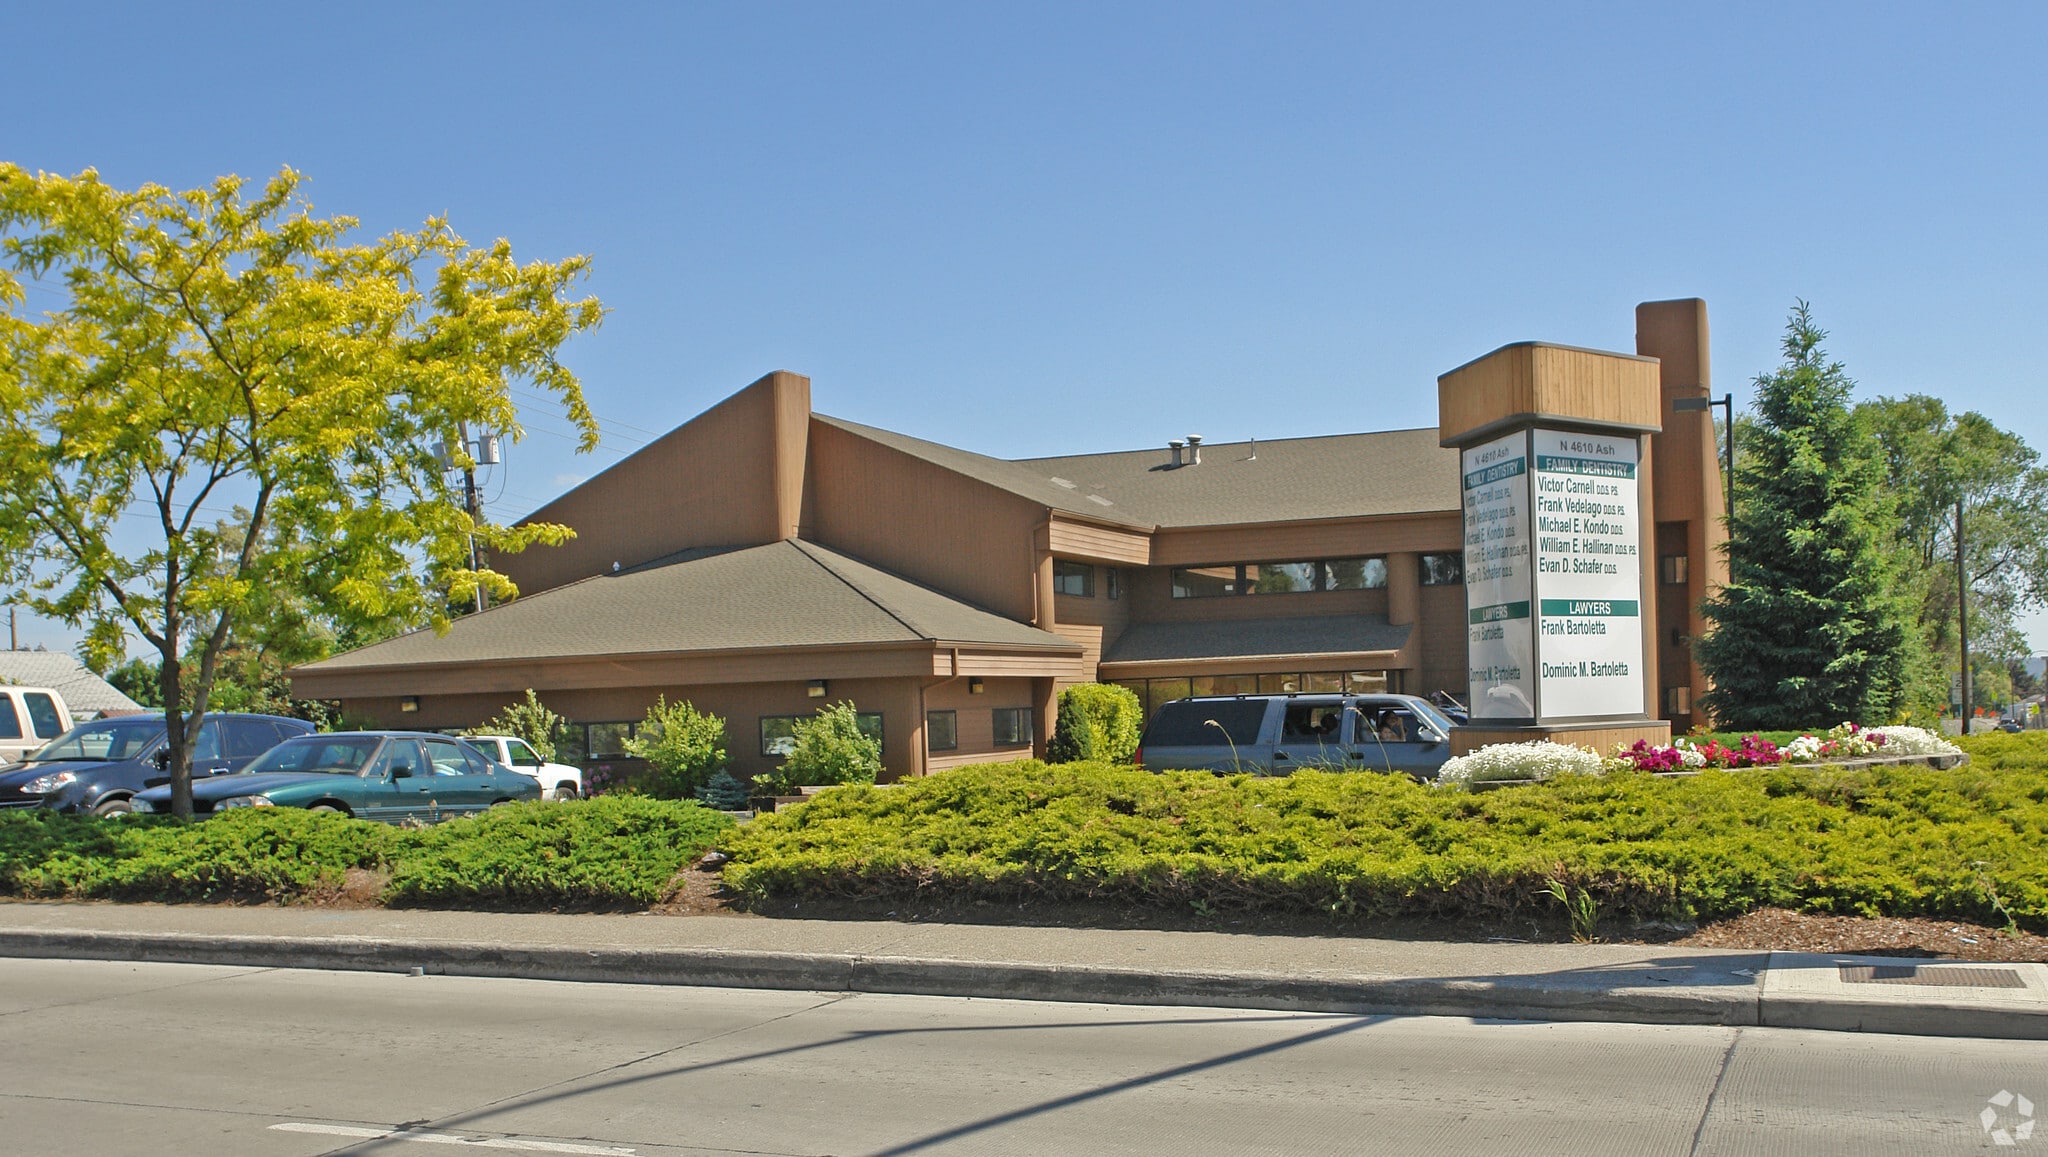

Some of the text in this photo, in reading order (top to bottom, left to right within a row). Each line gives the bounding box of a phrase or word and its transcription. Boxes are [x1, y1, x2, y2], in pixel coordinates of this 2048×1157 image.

[1475, 456, 1480, 466] N
[1497, 446, 1510, 458] Ash
[1560, 441, 1615, 456] N 4610 Ash
[1467, 460, 1518, 488] FAMILY DENTISTRY
[1546, 458, 1628, 477] FAMILY DENTISTRY
[1538, 476, 1564, 493] Victor
[1566, 478, 1595, 495] Carnell
[1538, 496, 1564, 512] Frank
[1566, 498, 1602, 518] Vedelago
[1538, 516, 1572, 533] Michael
[1574, 518, 1582, 534] E.
[1584, 518, 1609, 534] Kondo
[1539, 537, 1570, 552] William
[1572, 538, 1580, 553] E.
[1583, 538, 1614, 554] Hallinan
[1540, 557, 1560, 572] Evan
[1562, 558, 1571, 573] D.
[1573, 558, 1603, 574] Schafer
[1482, 606, 1508, 621] LAWYERS
[1570, 602, 1612, 614] LAWYERS
[1482, 624, 1504, 640] Bartoletta
[1542, 619, 1606, 634] Frank Bartoletta
[1542, 661, 1628, 678] Dominic M. Bartoletta
